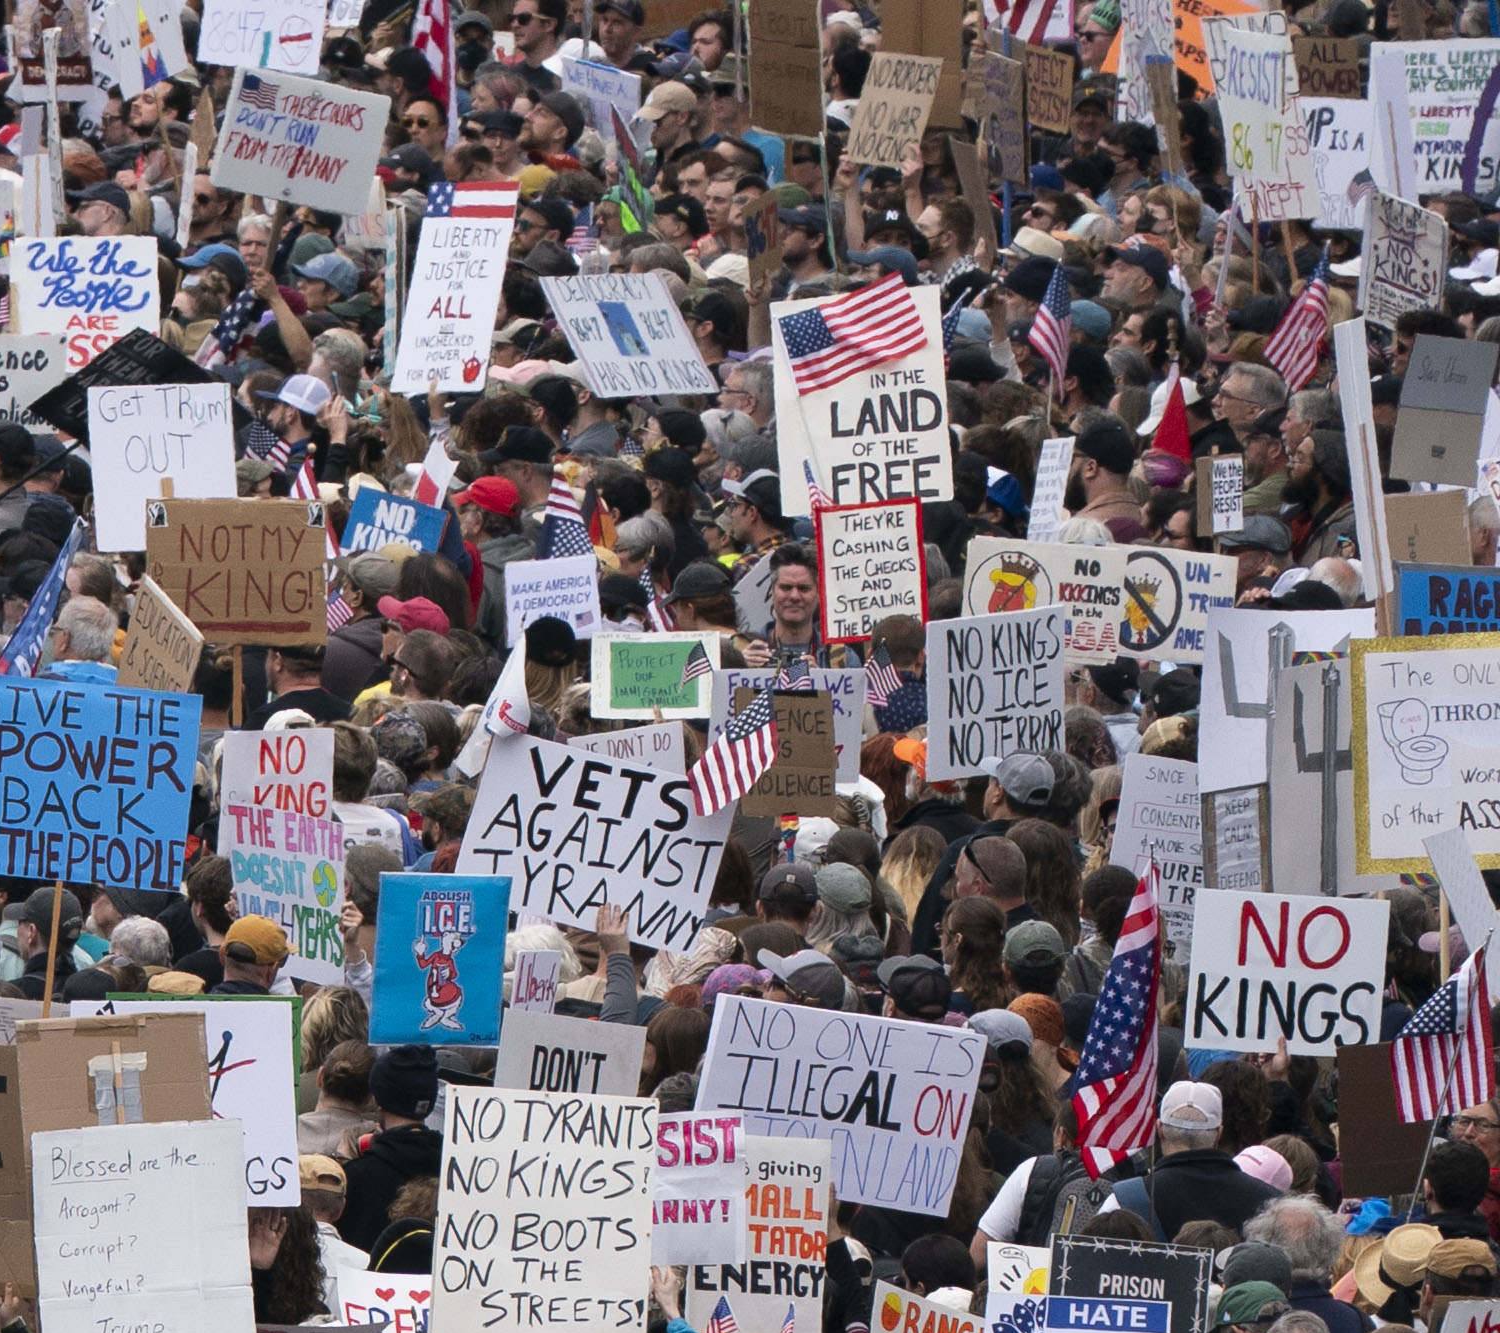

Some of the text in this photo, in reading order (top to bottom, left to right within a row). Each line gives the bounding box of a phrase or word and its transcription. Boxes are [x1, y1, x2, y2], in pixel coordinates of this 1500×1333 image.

[1308, 42, 1348, 62] ALL
[1300, 66, 1359, 95] POWER
[235, 111, 320, 148] DON'T RUN
[432, 227, 502, 249] LIBERTY
[26, 240, 151, 277] We the
[1386, 240, 1414, 266] NO
[425, 259, 489, 281] JUSTICE
[1374, 256, 1439, 296] KINGS!
[38, 276, 151, 313] People
[427, 296, 472, 319] ALL
[831, 391, 944, 438] LAND
[831, 457, 942, 502] FREE
[1213, 463, 1243, 479] We the
[1213, 477, 1243, 496] PEOPLE
[1213, 496, 1242, 513] RESIST
[181, 567, 316, 619] KING!
[533, 741, 691, 833] VETS
[421, 890, 473, 905] ABOLISH
[1237, 898, 1352, 970] NO
[1192, 970, 1377, 1045] KINGS
[1067, 1302, 1148, 1329] HATE
